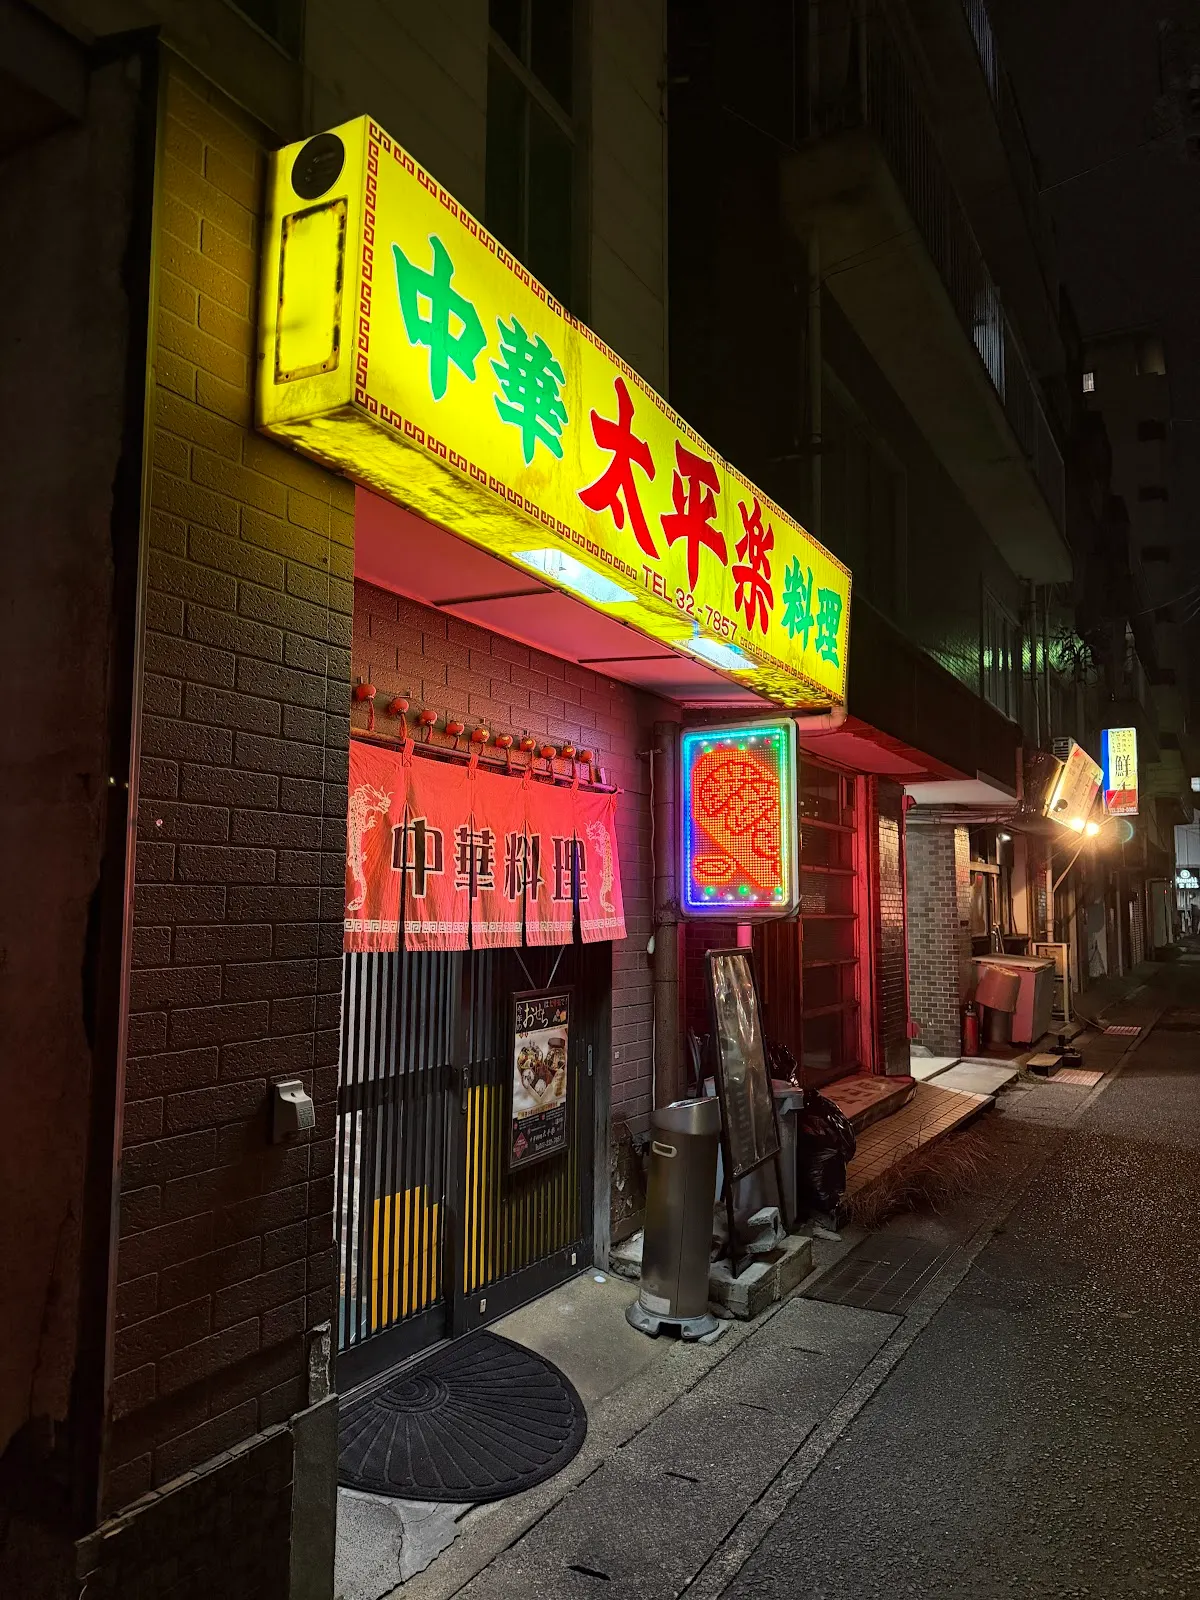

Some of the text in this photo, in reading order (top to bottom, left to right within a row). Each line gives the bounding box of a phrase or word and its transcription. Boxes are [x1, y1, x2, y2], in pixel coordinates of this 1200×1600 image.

[391, 233, 844, 669] 中華 太平楽 料理
[642, 563, 738, 641] TEL 32-7857
[391, 815, 589, 903] 中華料理
[522, 1002, 549, 1028] おせち
